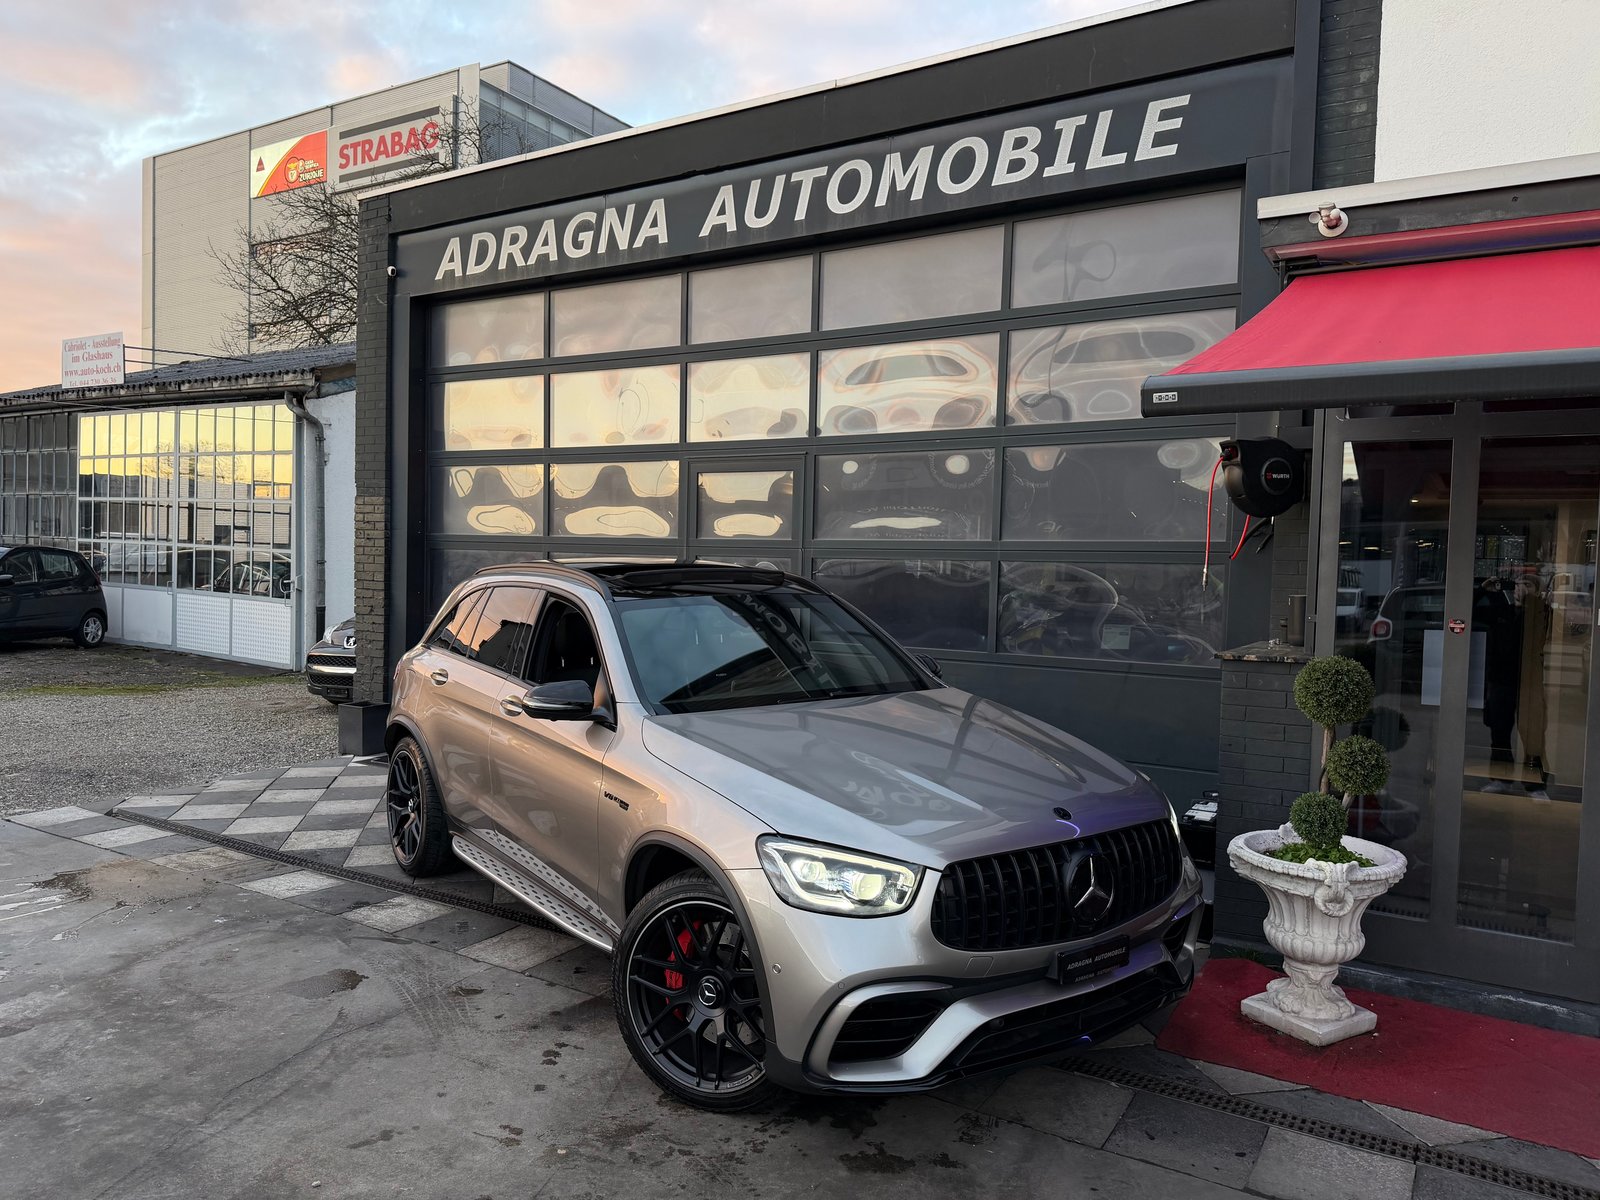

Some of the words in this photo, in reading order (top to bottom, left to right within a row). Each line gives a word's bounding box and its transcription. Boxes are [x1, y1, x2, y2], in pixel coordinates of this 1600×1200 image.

[339, 121, 439, 169] STRABAG
[435, 198, 668, 280] ADRAGNA
[698, 94, 1191, 238] AUTOMOBILE
[64, 340, 87, 352] Cabriolet
[72, 353, 80, 363] im
[82, 350, 113, 361] Glashaus
[64, 362, 121, 376] www.auto-koch.ch
